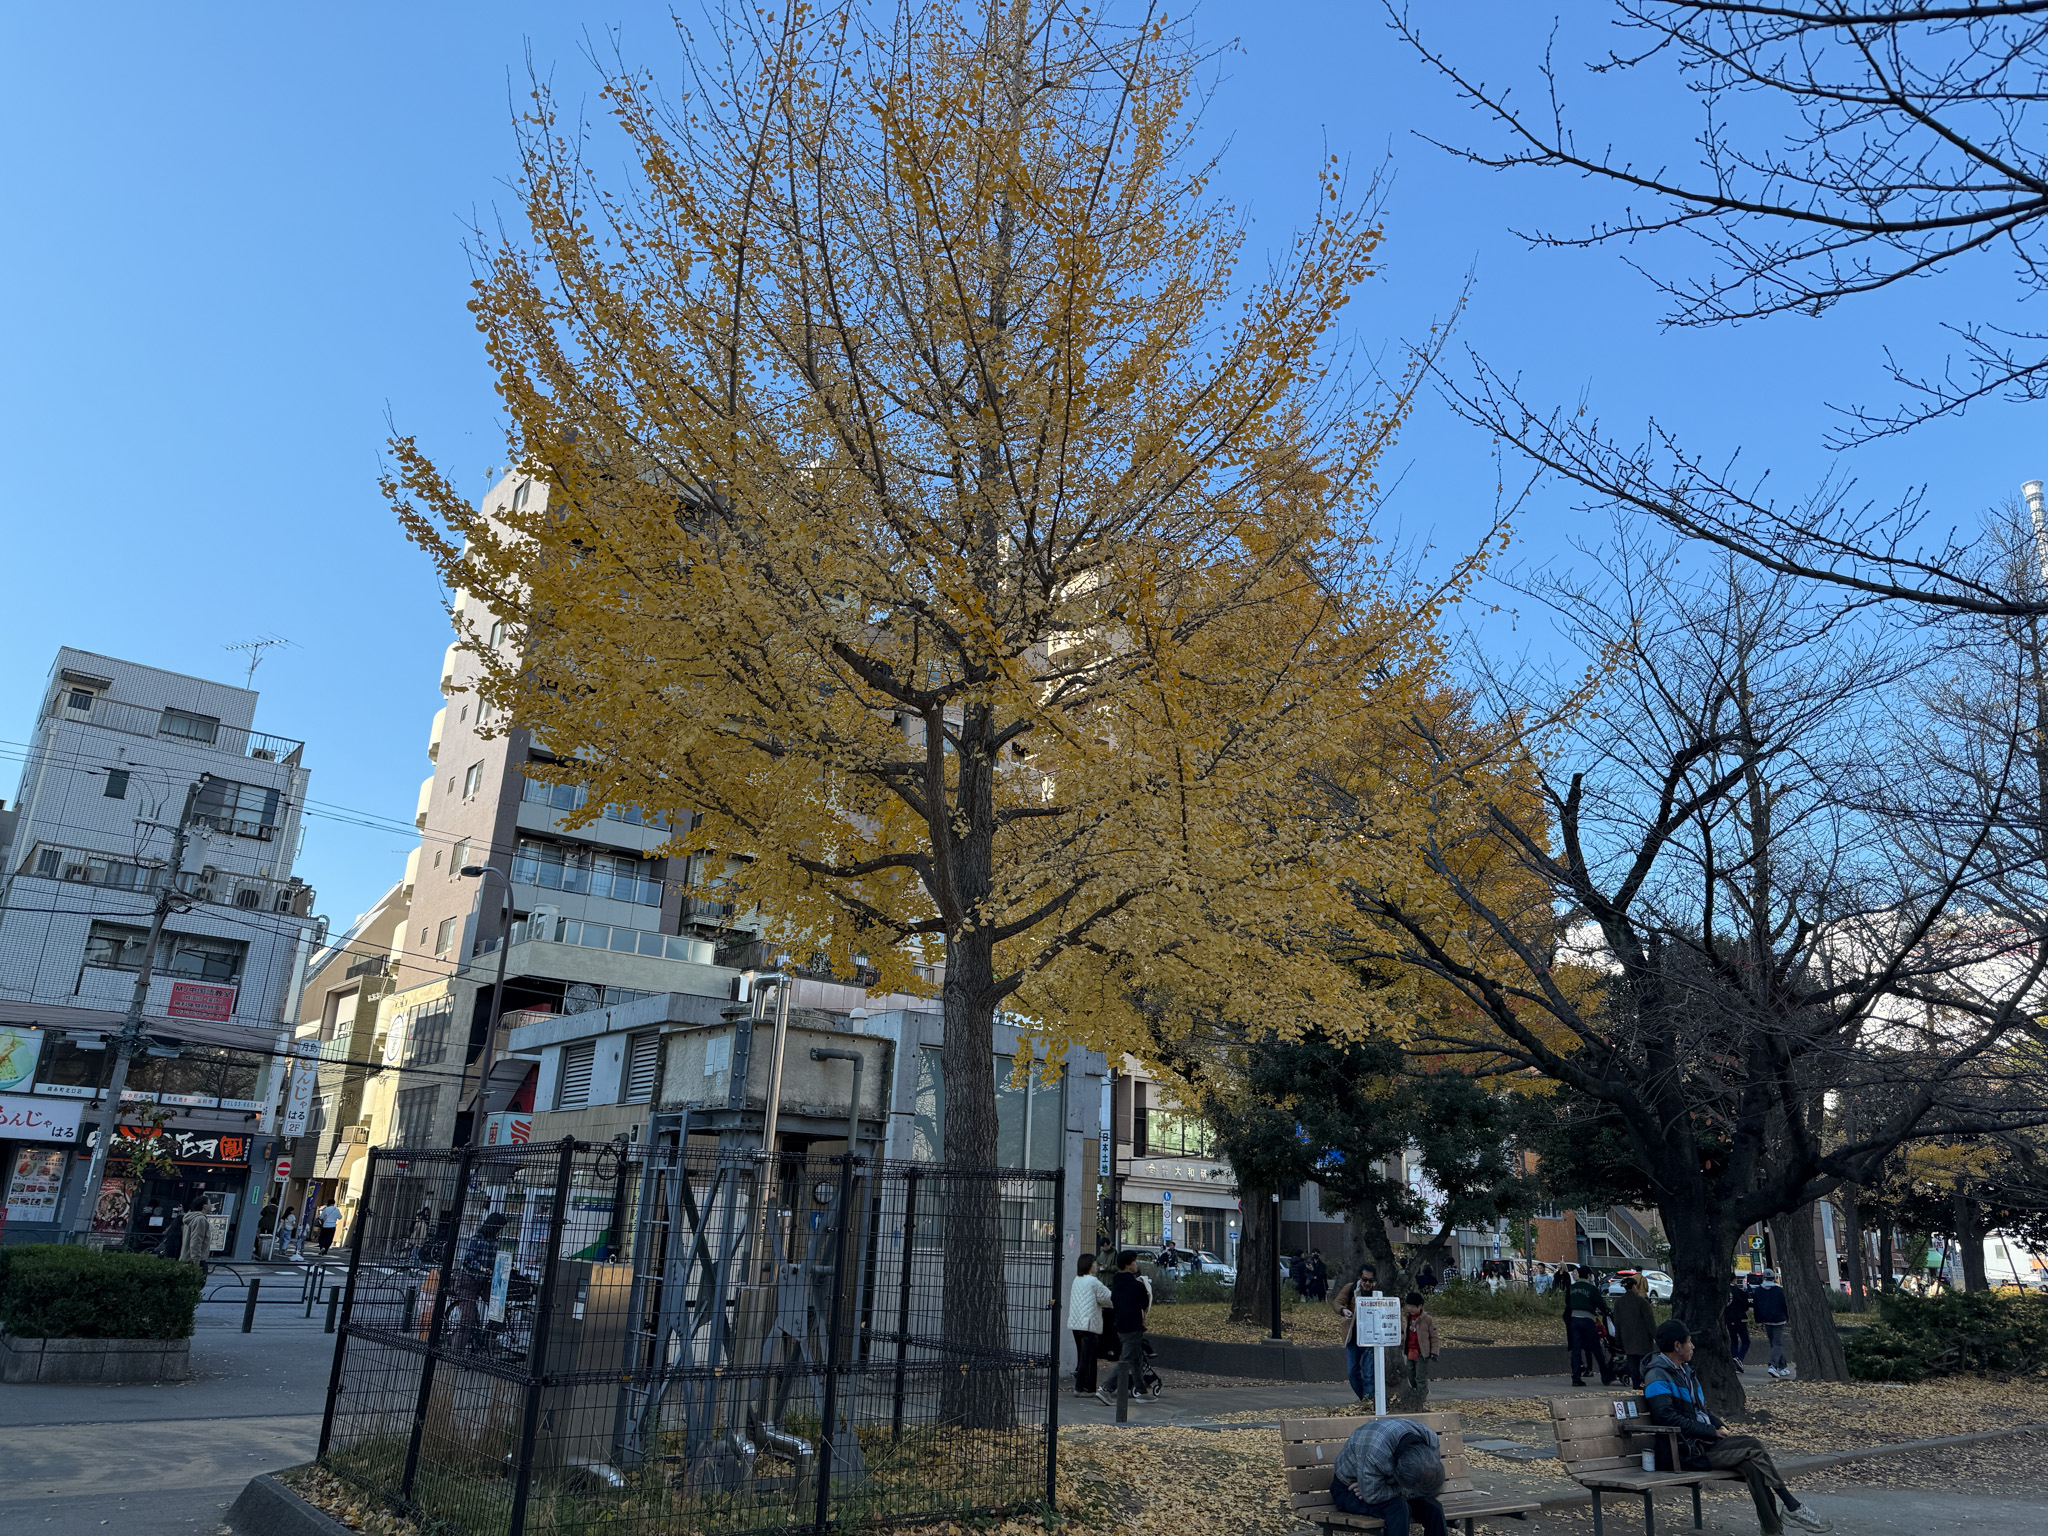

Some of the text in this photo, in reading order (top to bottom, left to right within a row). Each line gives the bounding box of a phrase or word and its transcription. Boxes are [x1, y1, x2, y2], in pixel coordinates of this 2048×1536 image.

[301, 1042, 318, 1053] 月島
[288, 1110, 306, 1120] はる
[51, 1126, 74, 1138] はる
[288, 1123, 301, 1132] 2F
[1101, 1132, 1109, 1174] 日本土地
